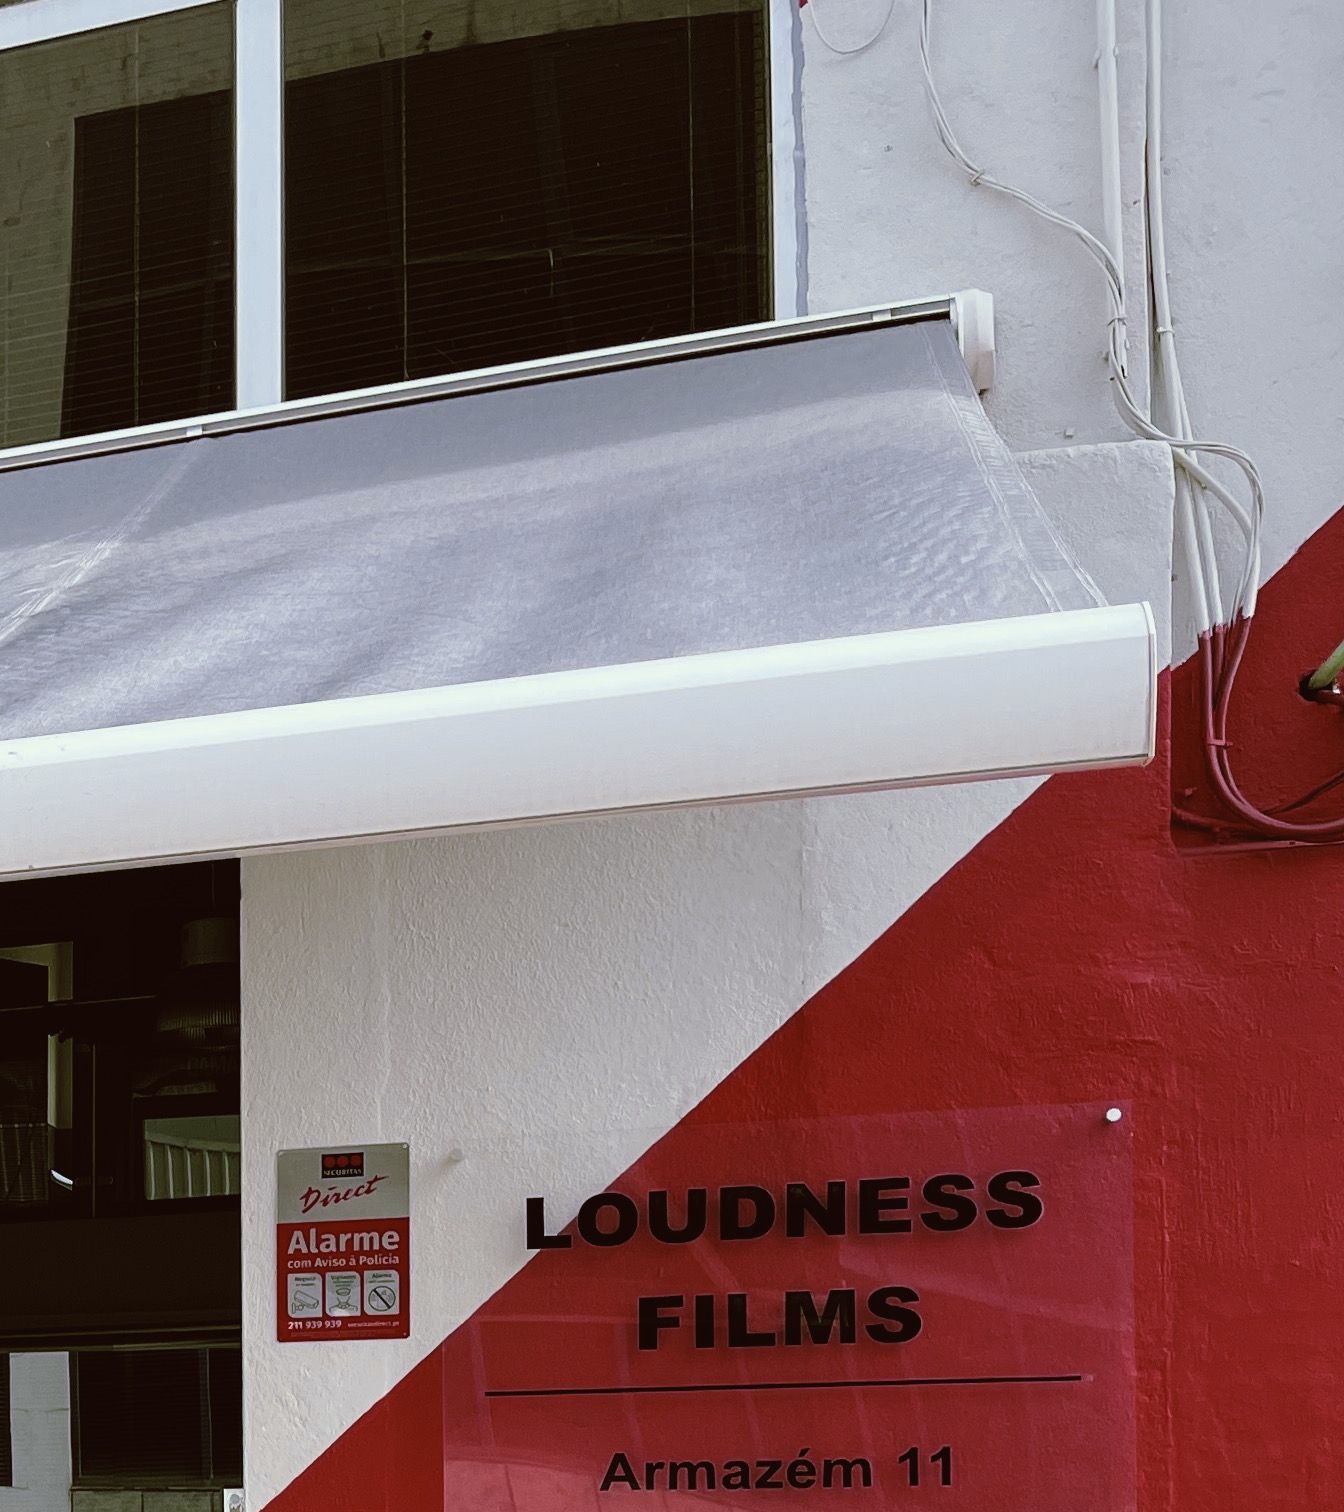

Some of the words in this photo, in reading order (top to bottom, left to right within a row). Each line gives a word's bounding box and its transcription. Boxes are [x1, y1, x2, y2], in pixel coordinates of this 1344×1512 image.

[299, 1174, 390, 1214] Direct
[524, 1169, 1045, 1251] LOUDNESS
[287, 1227, 400, 1255] Alarme
[287, 1260, 312, 1269] com
[314, 1255, 346, 1267] Aviso
[359, 1252, 399, 1265] Polícia
[288, 1321, 303, 1330] 211
[305, 1320, 323, 1329] 939
[324, 1319, 342, 1328] 939
[637, 1285, 924, 1351] FILMS
[599, 1447, 873, 1492] Armazém
[897, 1446, 954, 1488] 11
